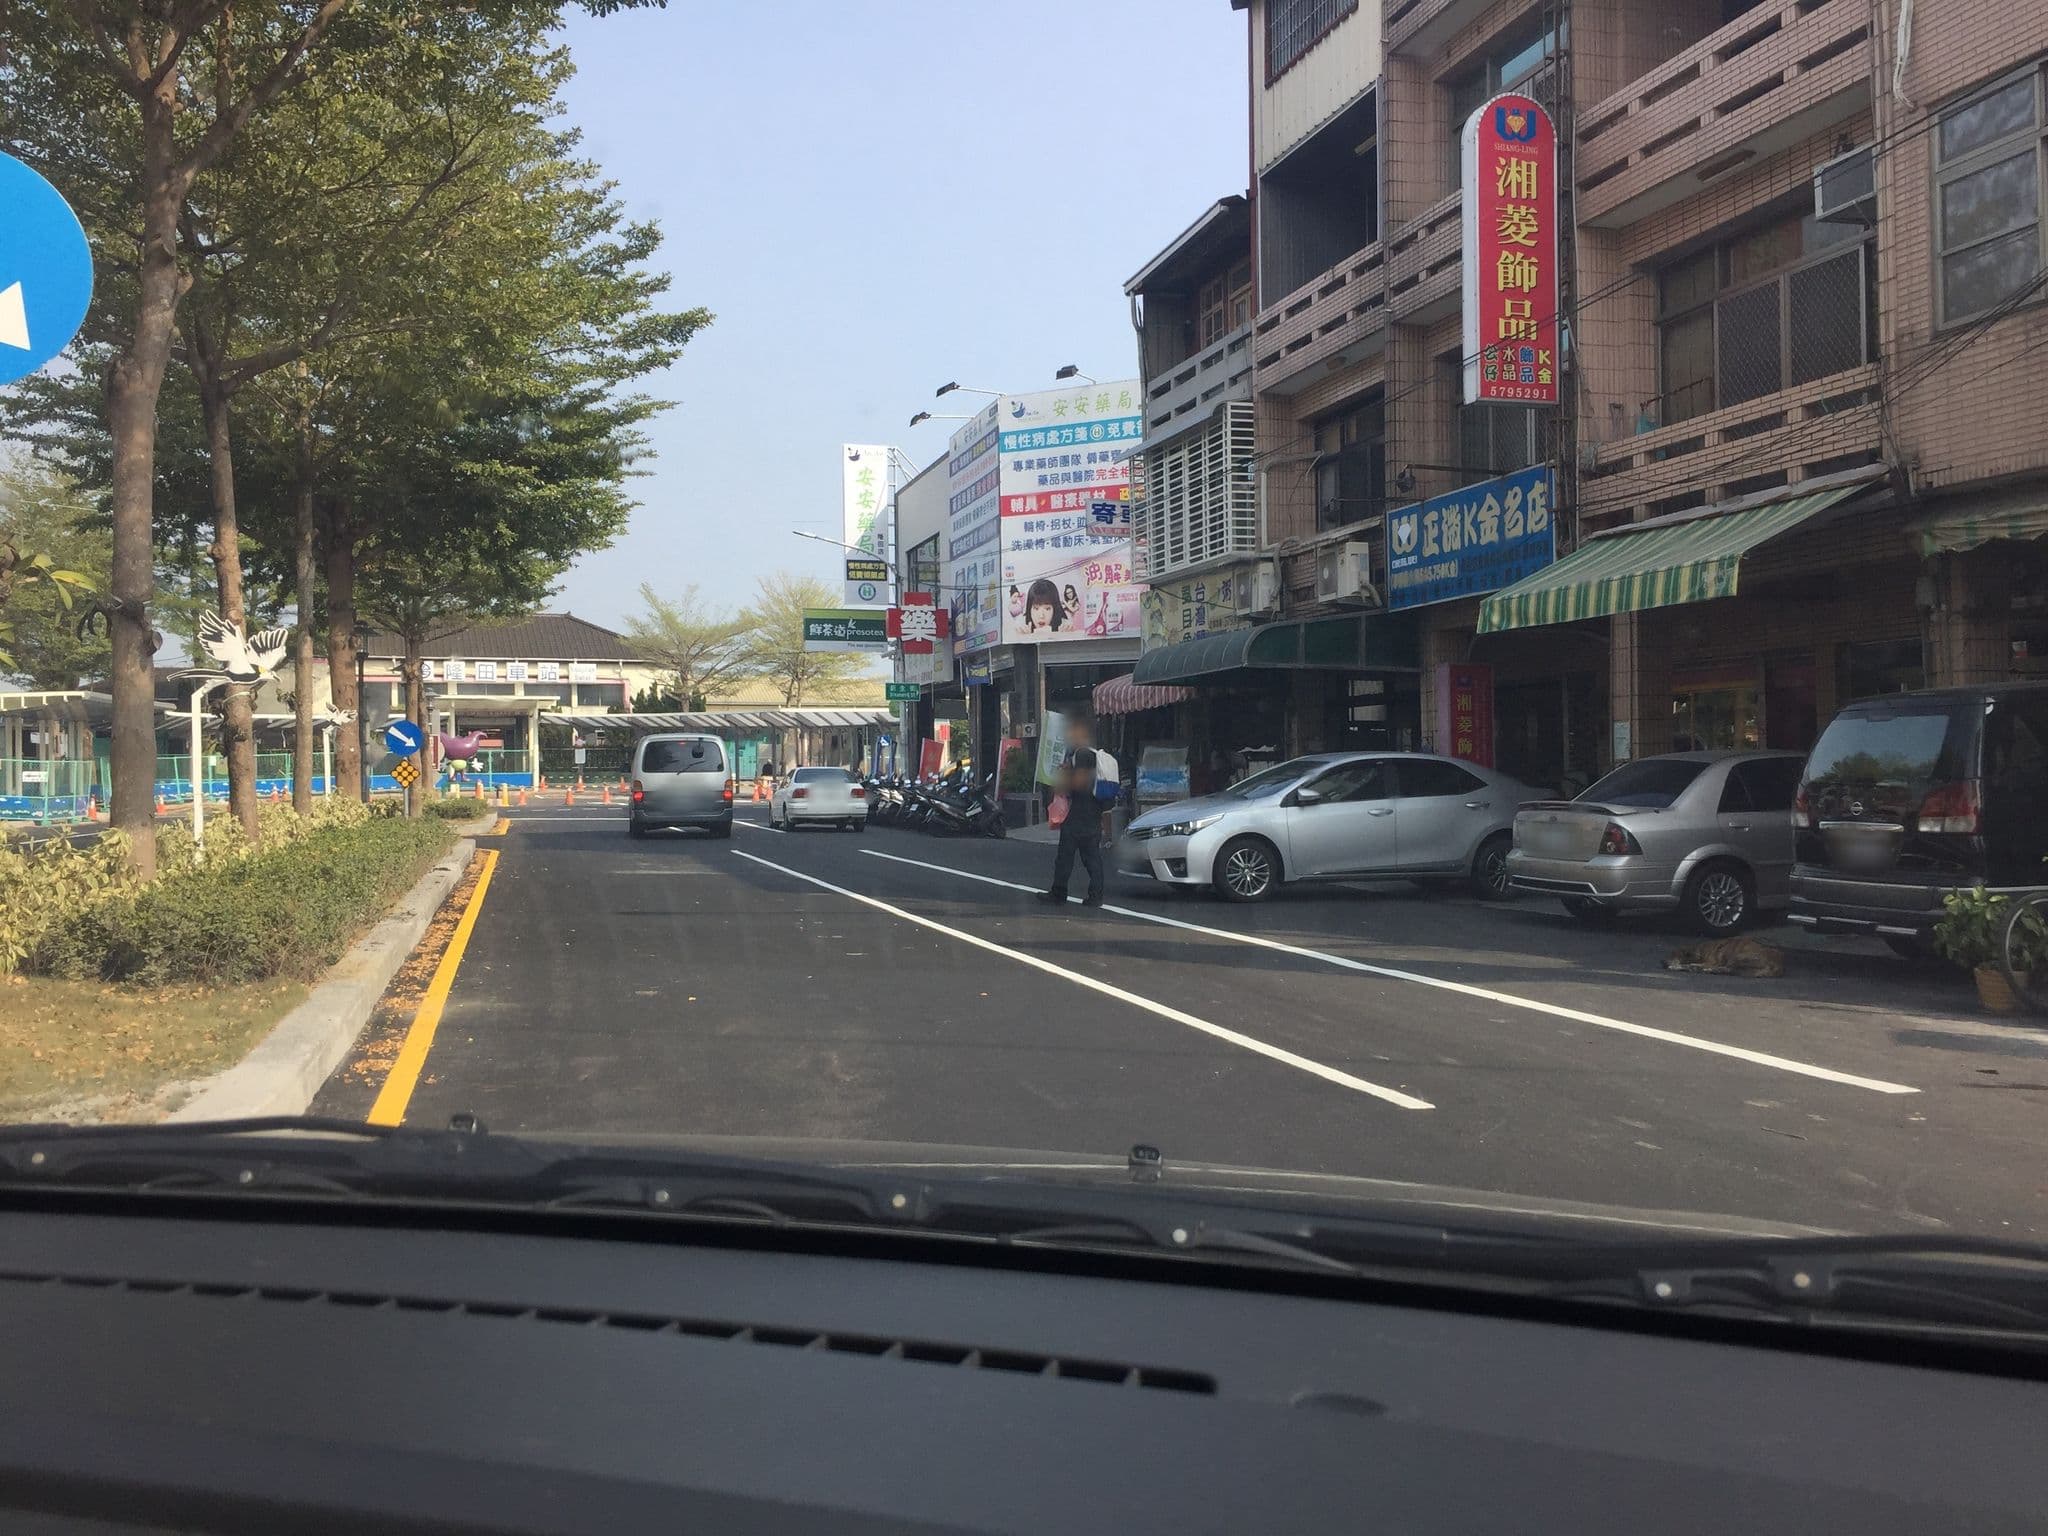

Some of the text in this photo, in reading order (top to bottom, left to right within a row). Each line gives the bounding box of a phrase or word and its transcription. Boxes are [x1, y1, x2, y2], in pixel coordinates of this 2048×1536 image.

[1495, 156, 1538, 341] 湘菱飾品
[1503, 346, 1516, 380] 水晶
[1538, 349, 1552, 384] K金
[1053, 391, 1132, 417] 安安藥局
[1490, 386, 1547, 399] 5795291
[1013, 454, 1082, 472] 專業藥師團隊
[856, 467, 876, 555] 安安藥局
[809, 623, 846, 637] 鮮茶道
[901, 604, 936, 642] 藥
[446, 663, 557, 681] 隆田車站
